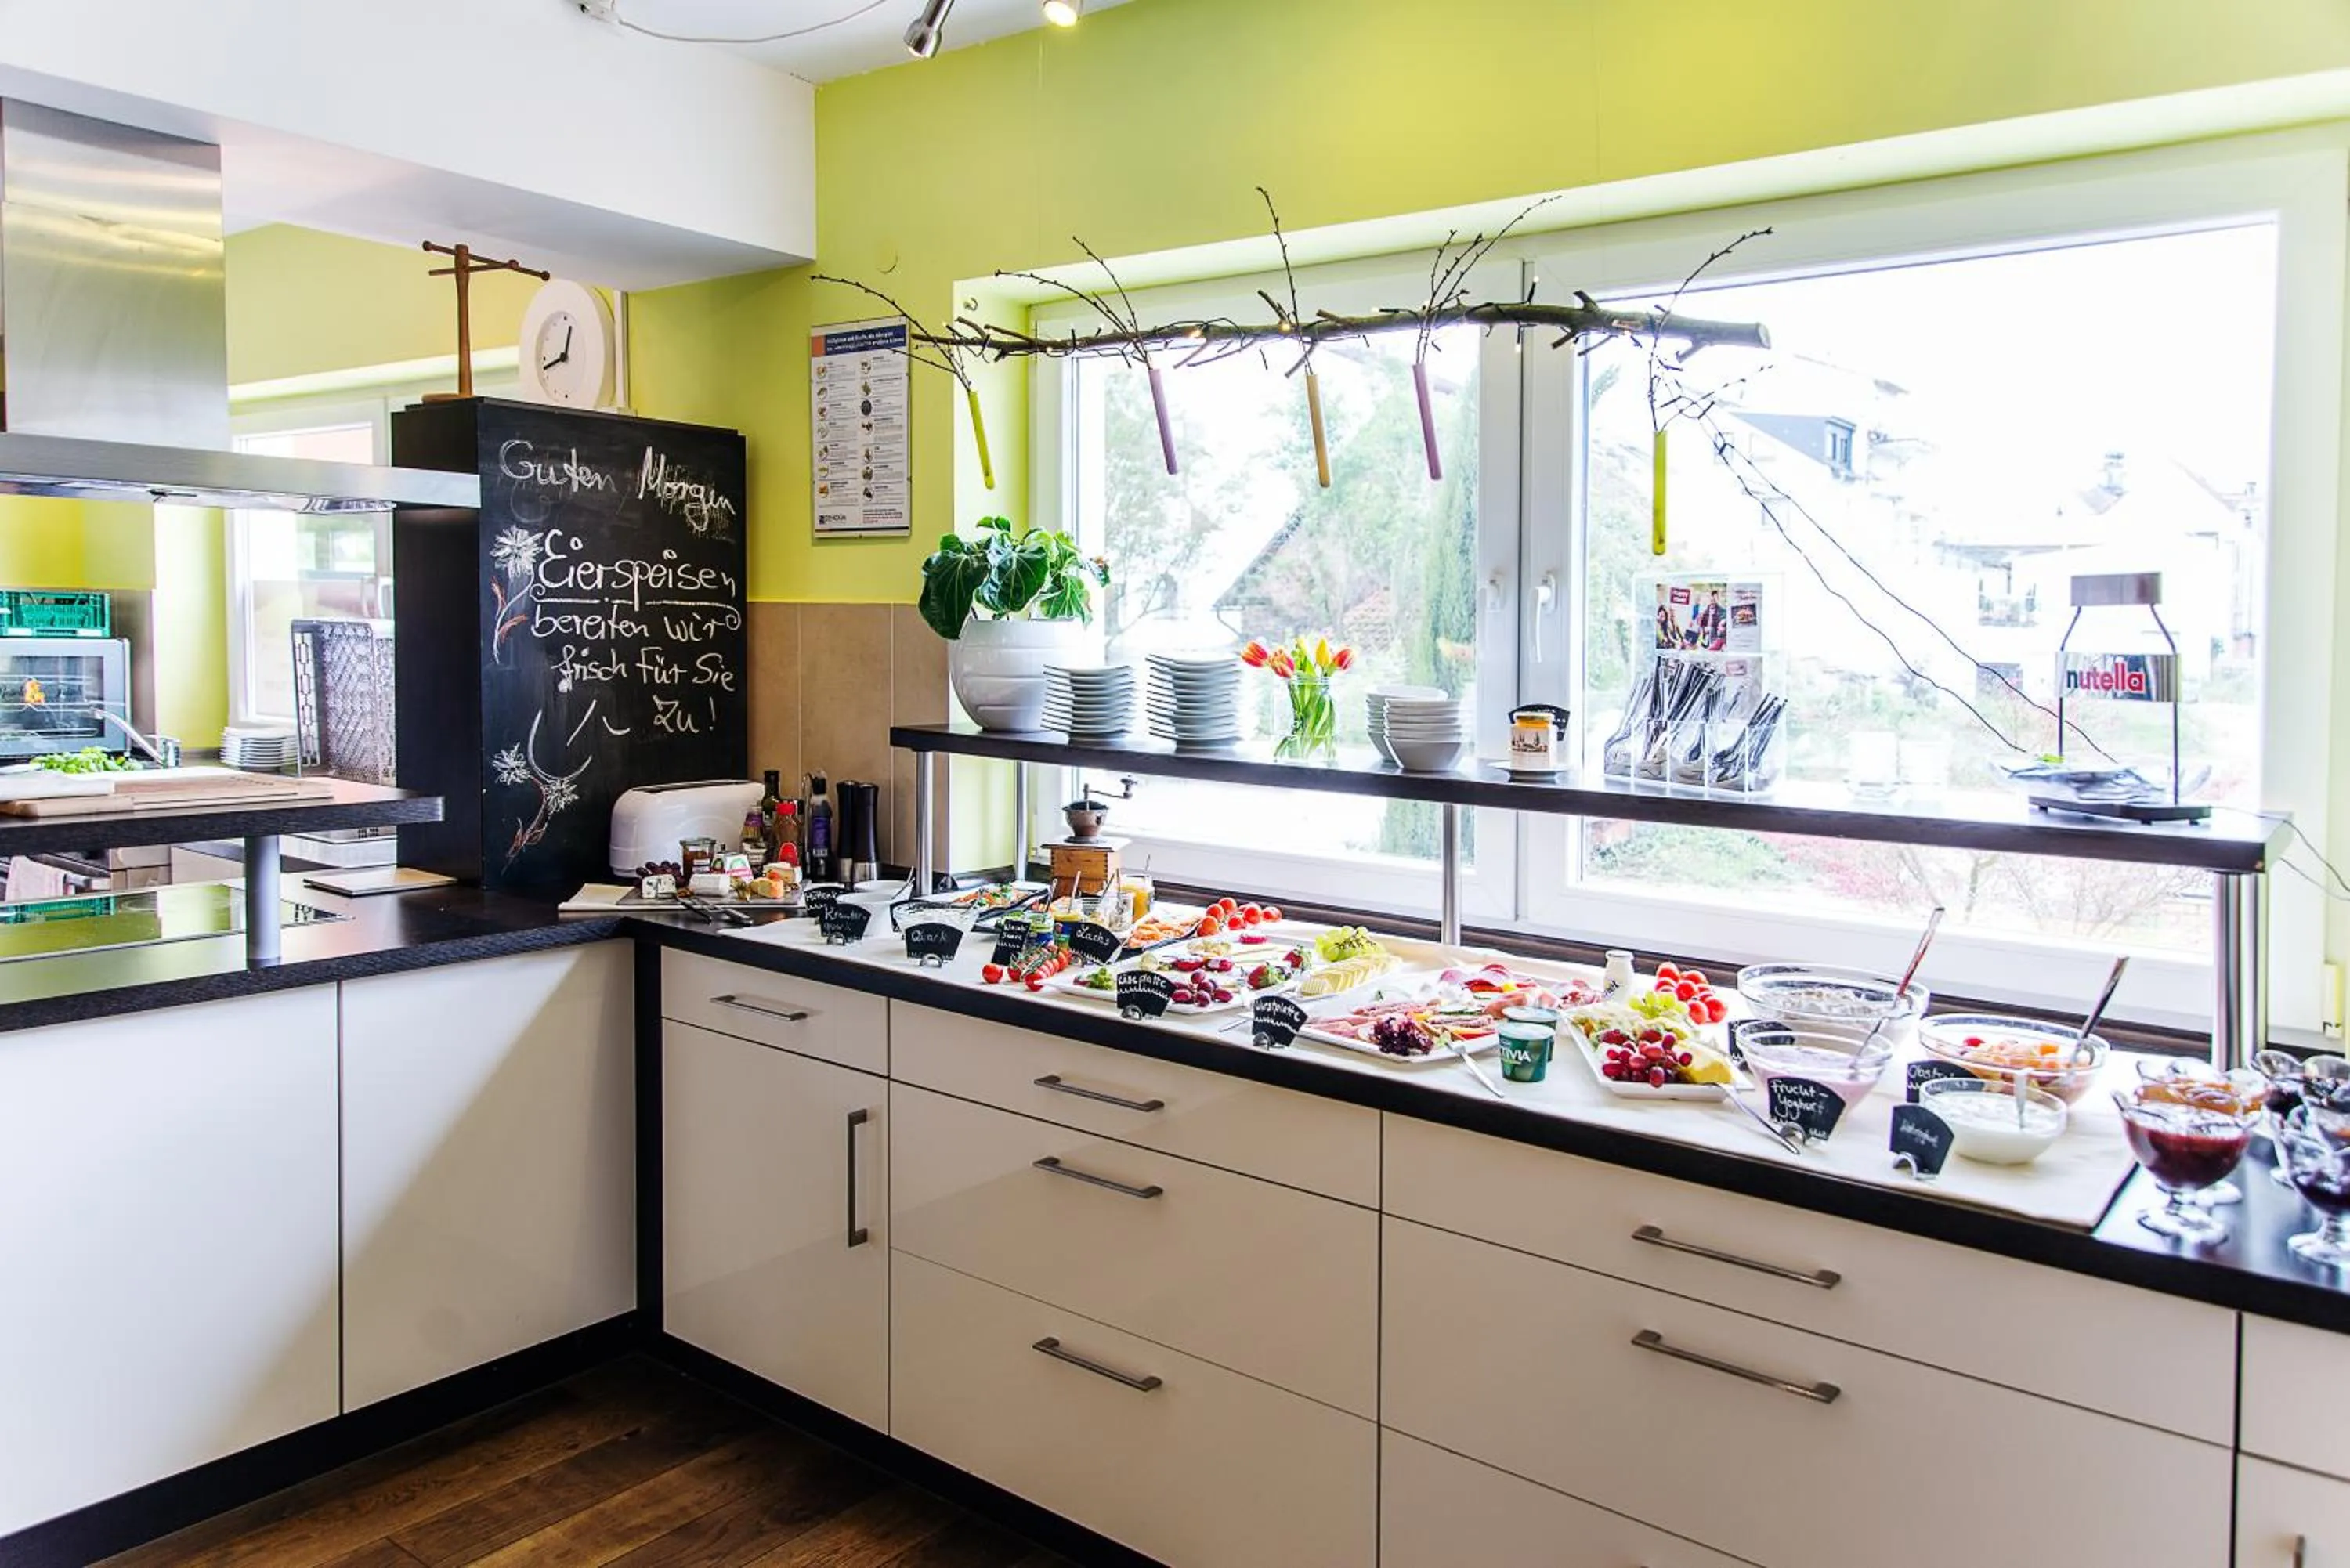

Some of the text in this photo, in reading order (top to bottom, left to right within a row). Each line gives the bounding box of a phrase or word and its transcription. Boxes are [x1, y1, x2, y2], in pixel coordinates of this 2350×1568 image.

[499, 439, 617, 493] Guten
[538, 529, 736, 612] Eierspeisen
[531, 604, 649, 640] bereiten
[551, 645, 627, 693] frisch
[692, 653, 736, 692] Sie
[2066, 662, 2145, 692] nutella
